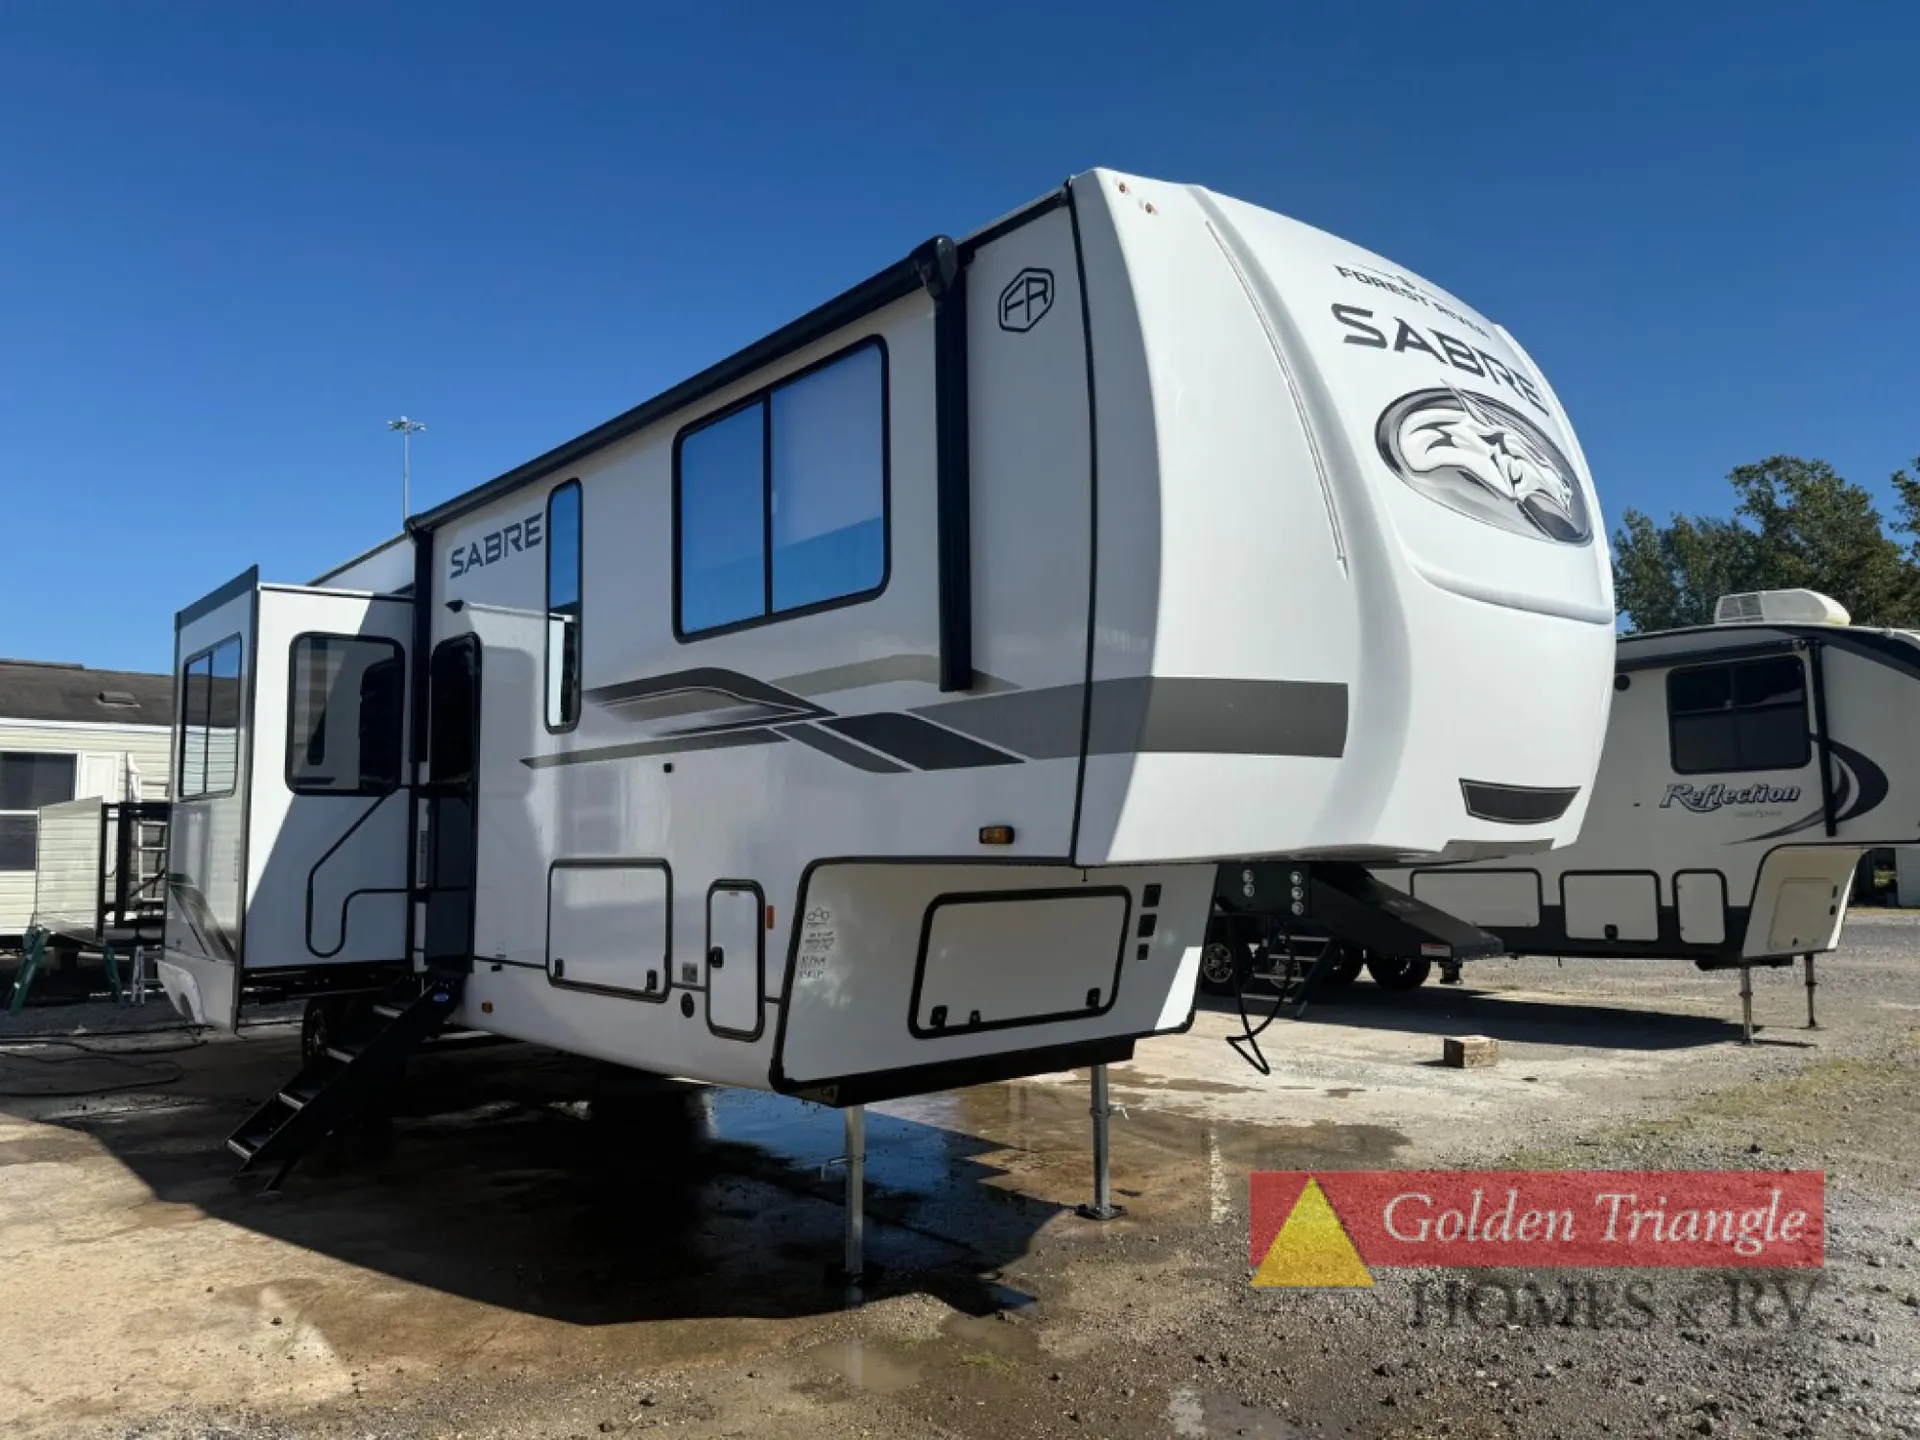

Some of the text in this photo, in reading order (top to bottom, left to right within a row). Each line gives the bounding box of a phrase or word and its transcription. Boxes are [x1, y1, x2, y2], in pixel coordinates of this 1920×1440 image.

[1331, 303, 1550, 417] SABRE
[450, 511, 544, 580] SABRE
[1659, 783, 1801, 813] Reflection
